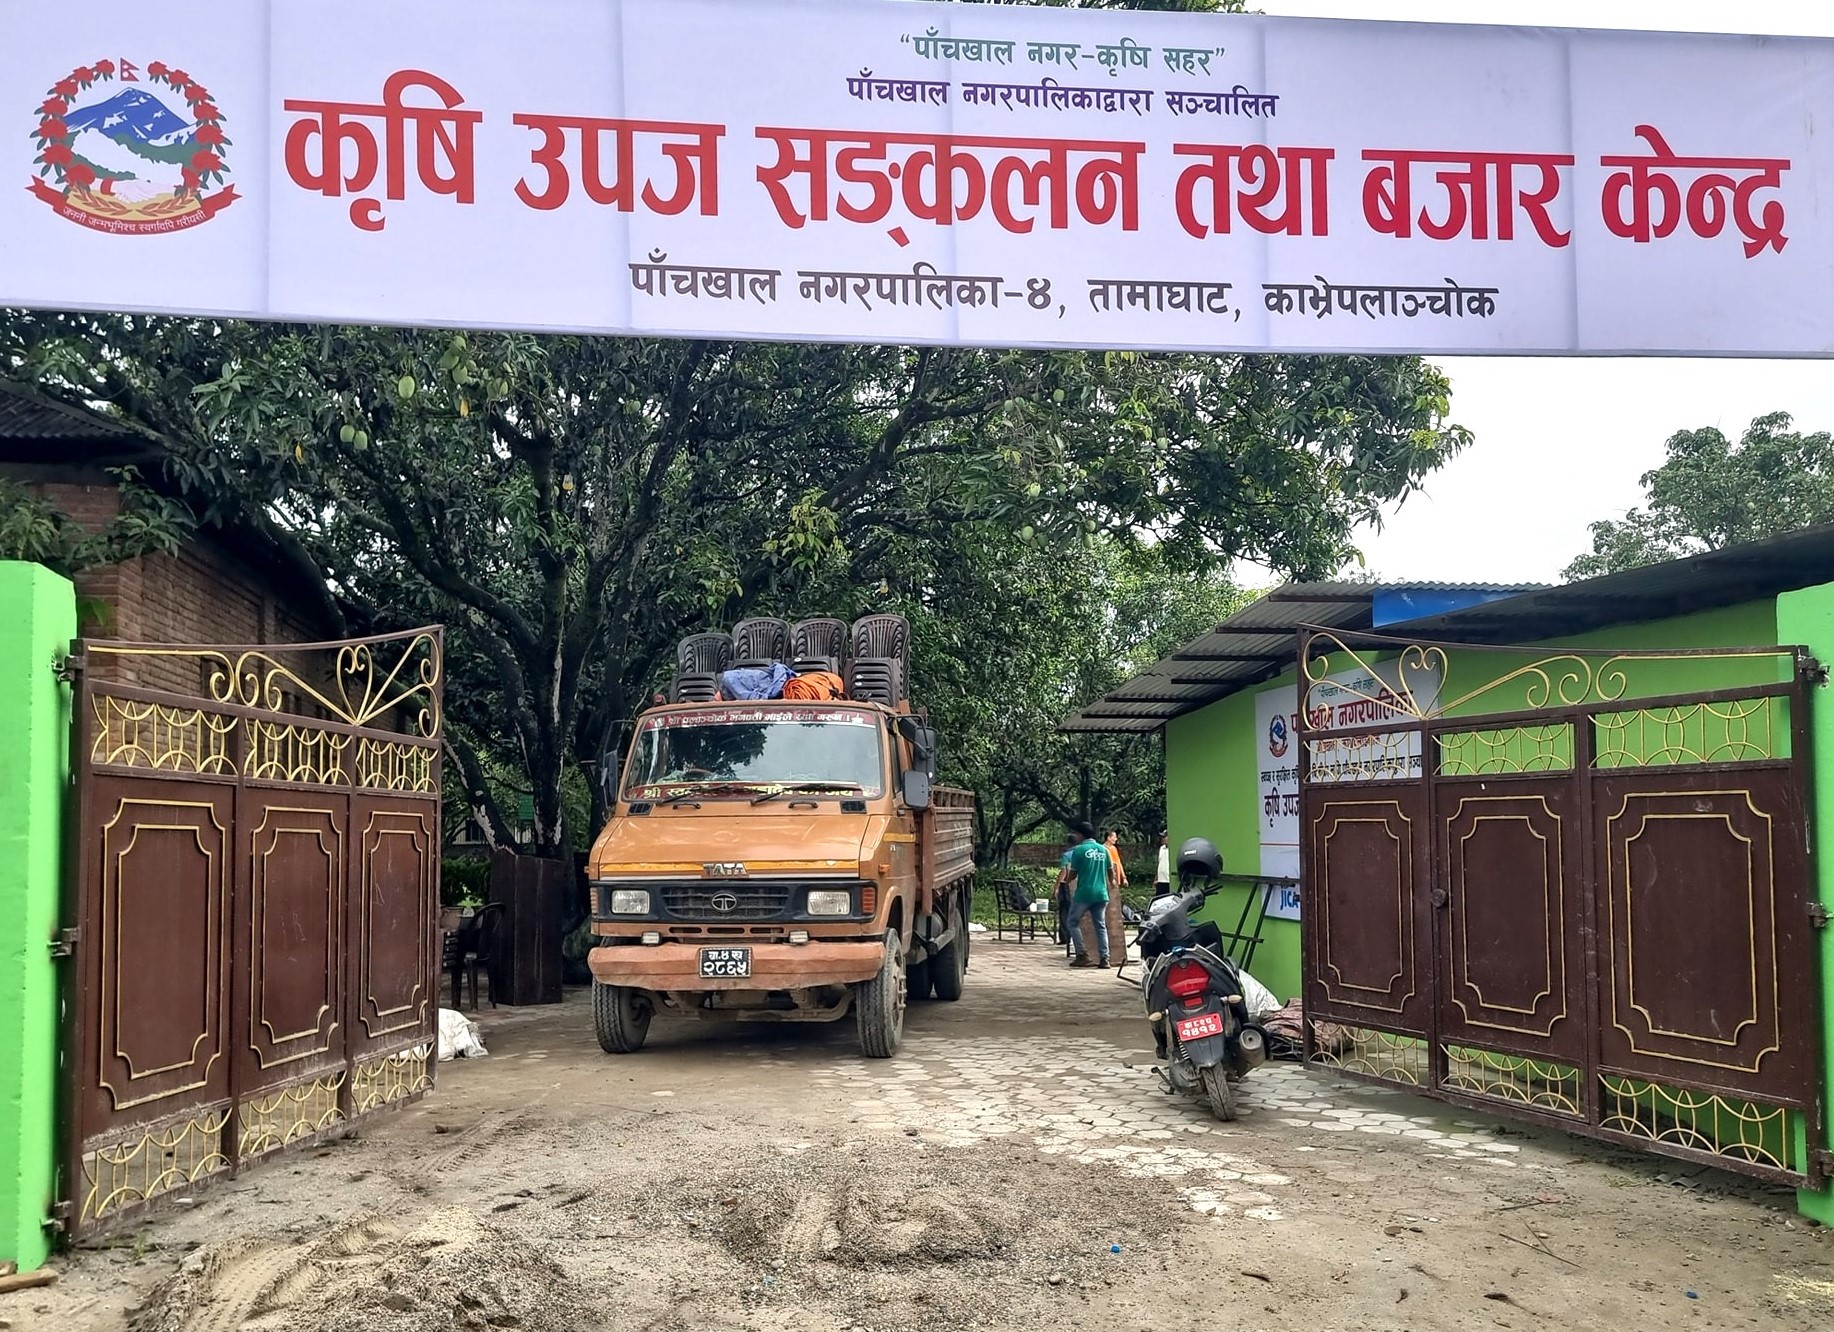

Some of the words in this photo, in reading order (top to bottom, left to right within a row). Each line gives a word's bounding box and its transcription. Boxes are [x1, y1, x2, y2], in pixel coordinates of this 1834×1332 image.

[846, 67, 951, 105] पाँचखाल
[962, 77, 1155, 115] नगरपालिकाद्वारा
[1165, 85, 1280, 119] सञ्चालित
[284, 70, 483, 231] कृषि
[513, 113, 726, 216] उपज
[755, 127, 1146, 247] सङ्कलन
[1173, 143, 1335, 239] तथा
[1361, 149, 1575, 250] बजार
[1600, 125, 1791, 259] केन्द्र
[628, 248, 781, 304] पाँचखाल
[1087, 280, 1240, 322] तामाघाट,
[1261, 275, 1499, 319] काभ्रेपलाञ्चोक
[703, 863, 747, 876] TATA
